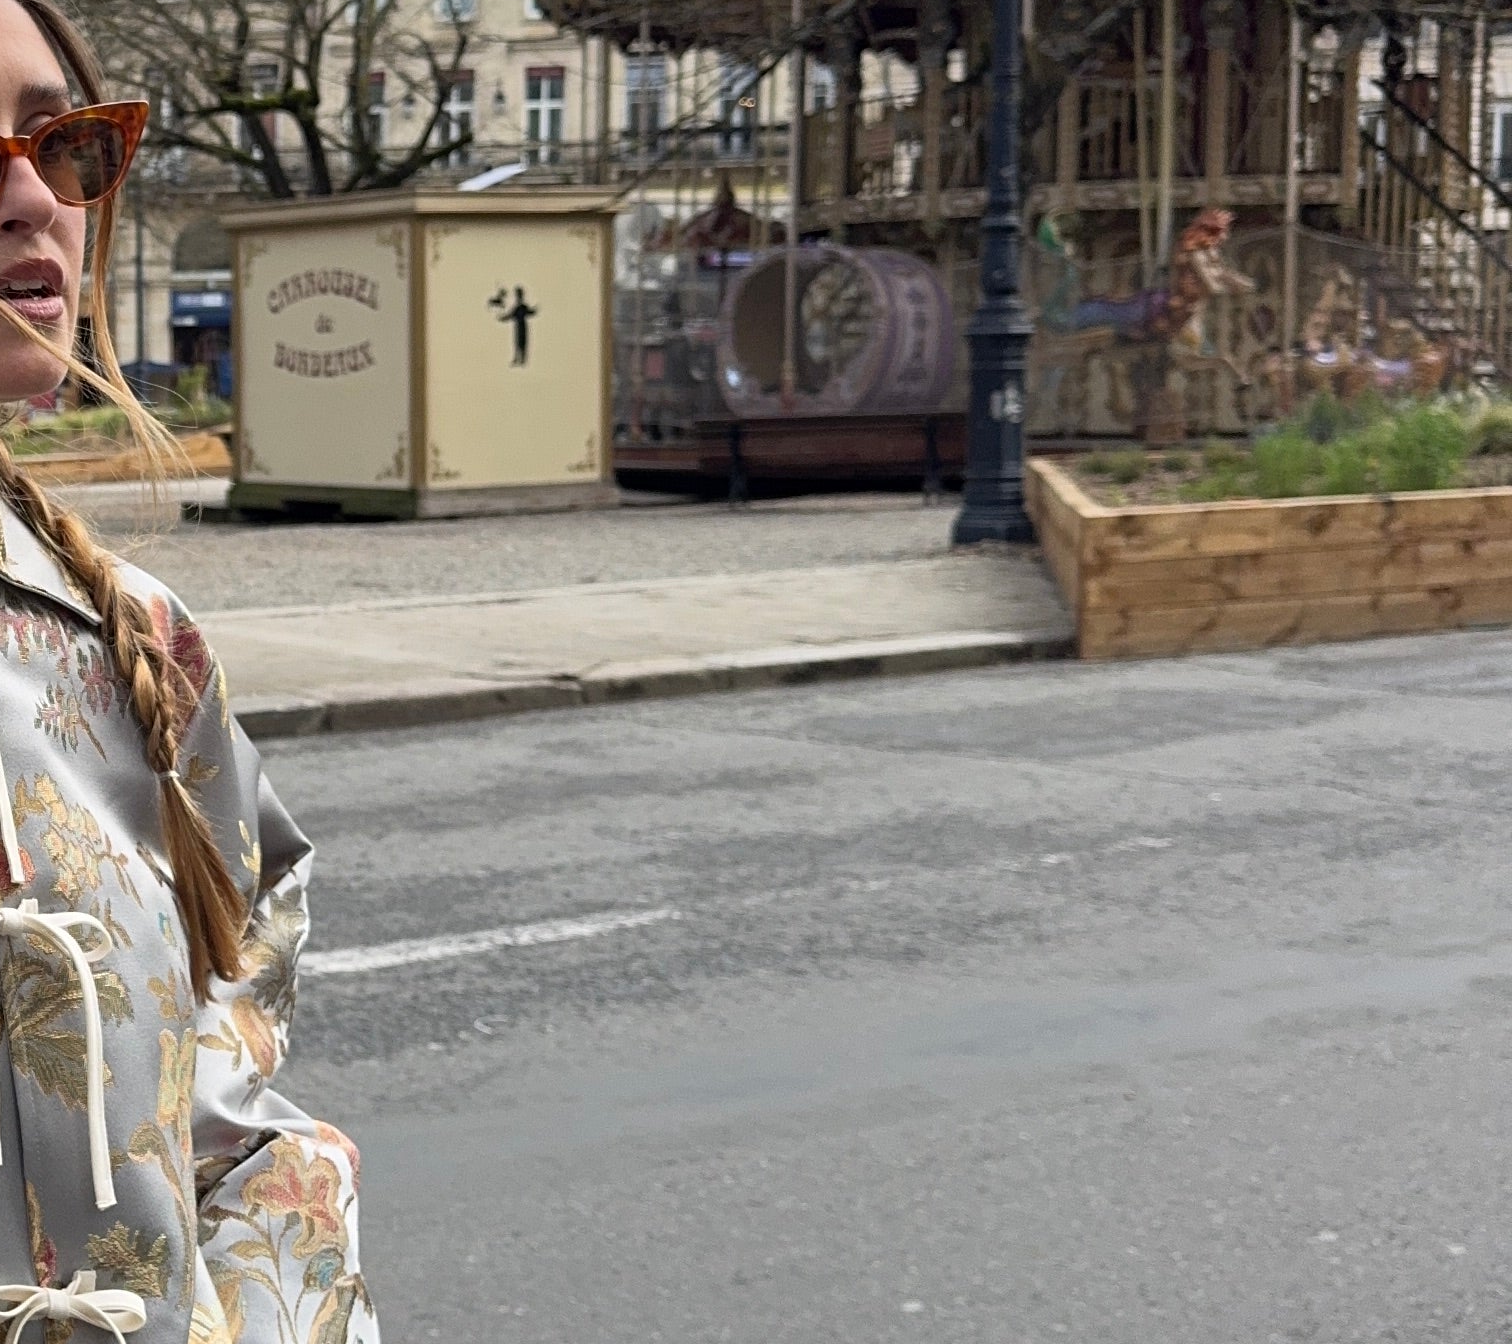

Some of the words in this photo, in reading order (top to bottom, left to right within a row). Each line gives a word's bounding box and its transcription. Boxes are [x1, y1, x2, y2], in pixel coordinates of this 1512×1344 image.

[267, 268, 378, 314] CARROUSEL
[314, 312, 334, 334] de
[274, 340, 375, 378] BORDEAUX
